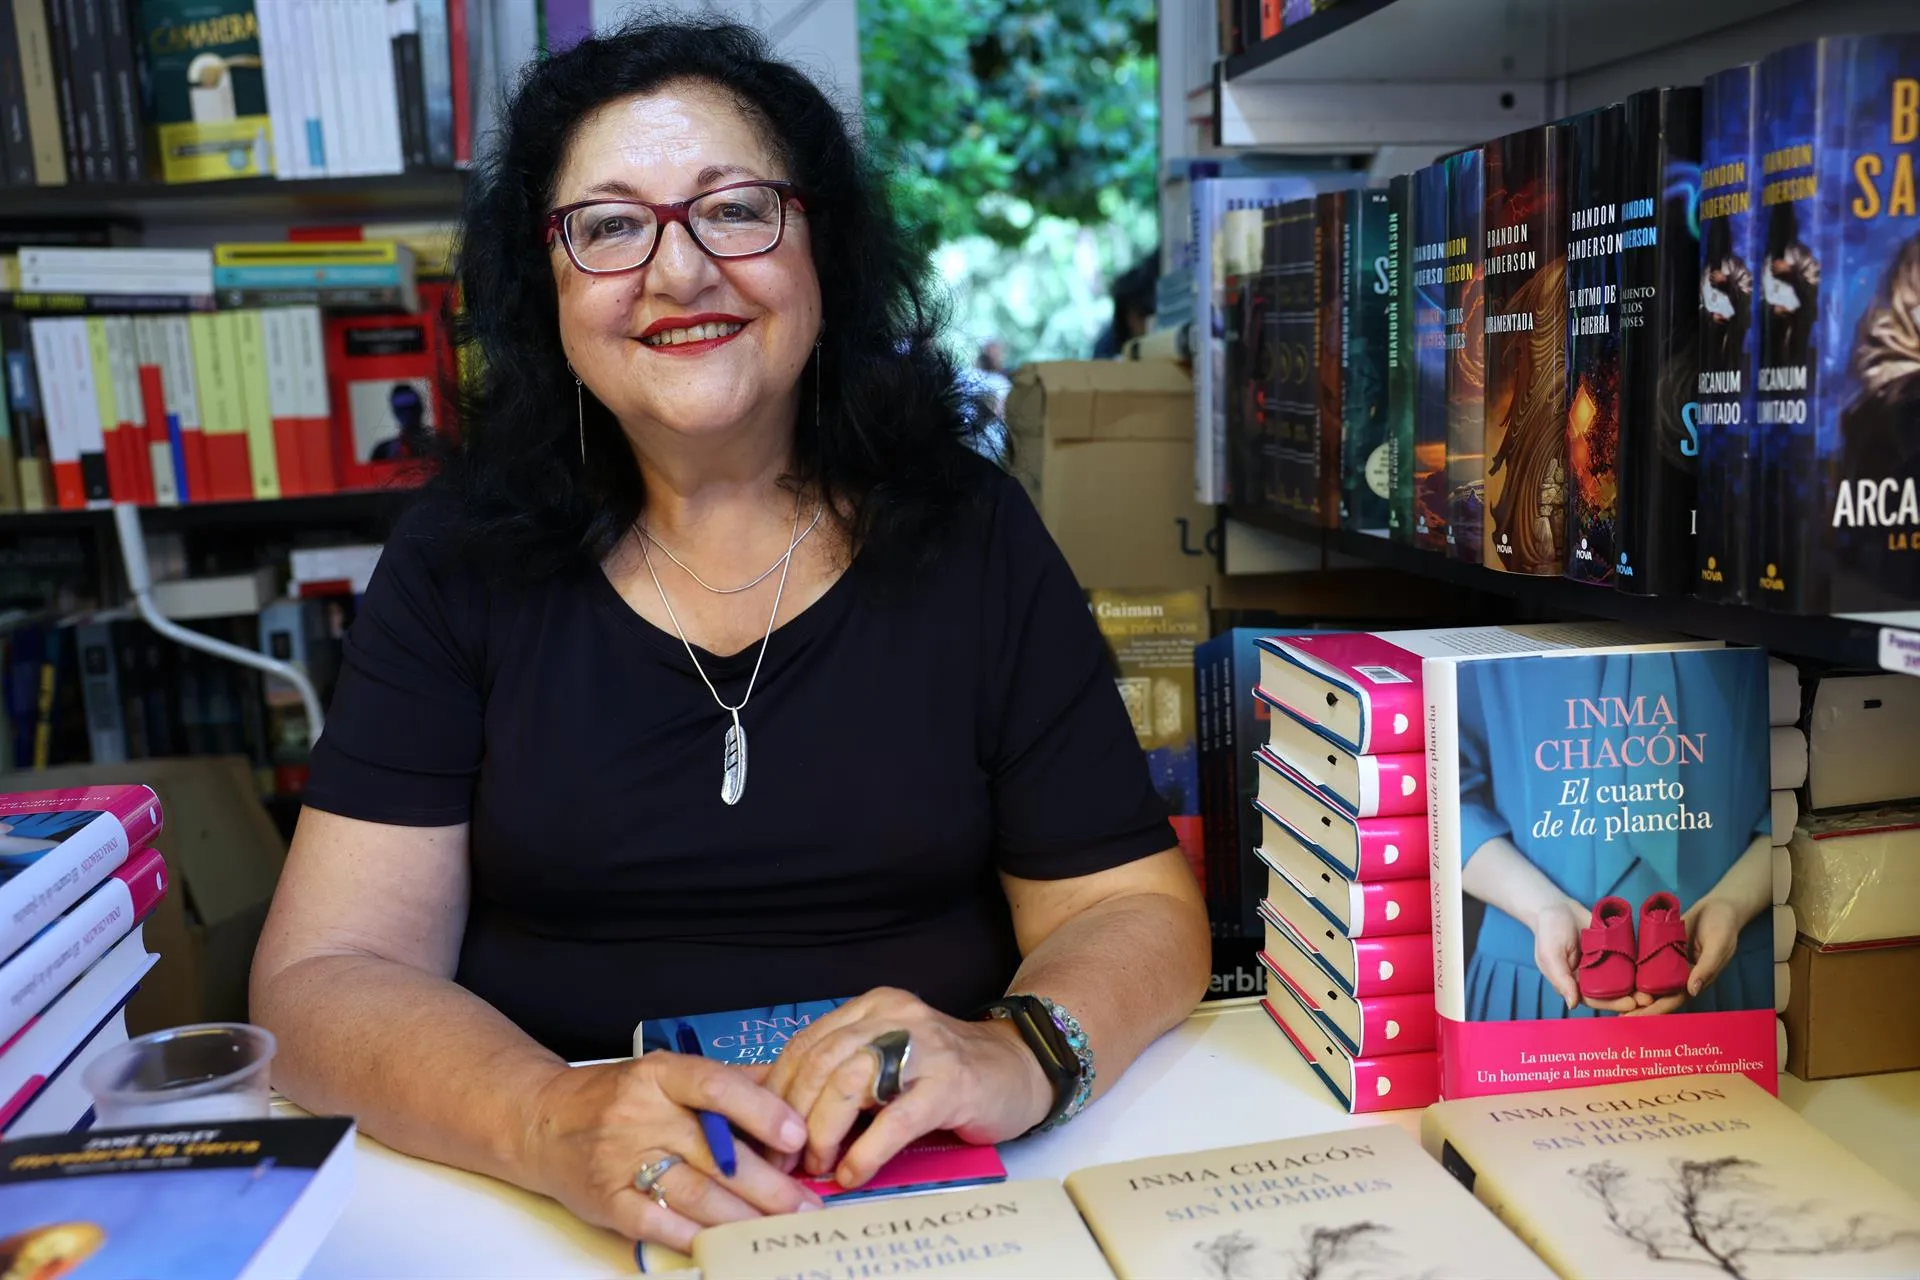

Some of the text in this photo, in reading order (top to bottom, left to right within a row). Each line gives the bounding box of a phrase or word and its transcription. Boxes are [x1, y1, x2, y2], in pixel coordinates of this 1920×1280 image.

[1571, 204, 1616, 231] BRANDON
[1487, 224, 1528, 248] BRANDON
[1567, 233, 1623, 262] SANDERSON
[1485, 251, 1536, 276] SANDERSON
[1577, 286, 1601, 307] RITMO
[1604, 284, 1616, 304] DE
[1581, 315, 1610, 335] GUERRA
[1832, 477, 1920, 528] ARCA
[1497, 544, 1513, 555] NOVA
[1576, 549, 1593, 561] NOVA
[1097, 602, 1164, 618] Gaiman
[1564, 695, 1677, 730] INMA
[1428, 705, 1438, 763] plancha
[1535, 726, 1707, 771] CHACÓN
[1558, 778, 1684, 806] El cuarto
[1532, 804, 1713, 841] de la plancha
[737, 1045, 765, 1058] El
[1521, 1043, 1723, 1064] La nueva novela de Inma Chacón.
[1477, 1059, 1764, 1084] Un homenaje a las madres valientes y cómplices
[1489, 1088, 1727, 1122] INMA CHACÓN
[1532, 1118, 1751, 1151] SIN HOMBRES
[1566, 1110, 1688, 1133] TIERRA
[1127, 1145, 1377, 1191] INMA CHACÓN
[1205, 1172, 1331, 1199] TIERRA
[1165, 1177, 1393, 1223] SIN HOMBRES
[751, 1202, 1020, 1254] INMA CHACÓN
[832, 1234, 960, 1263] TIERRA
[846, 1240, 1023, 1280] HOMBRES
